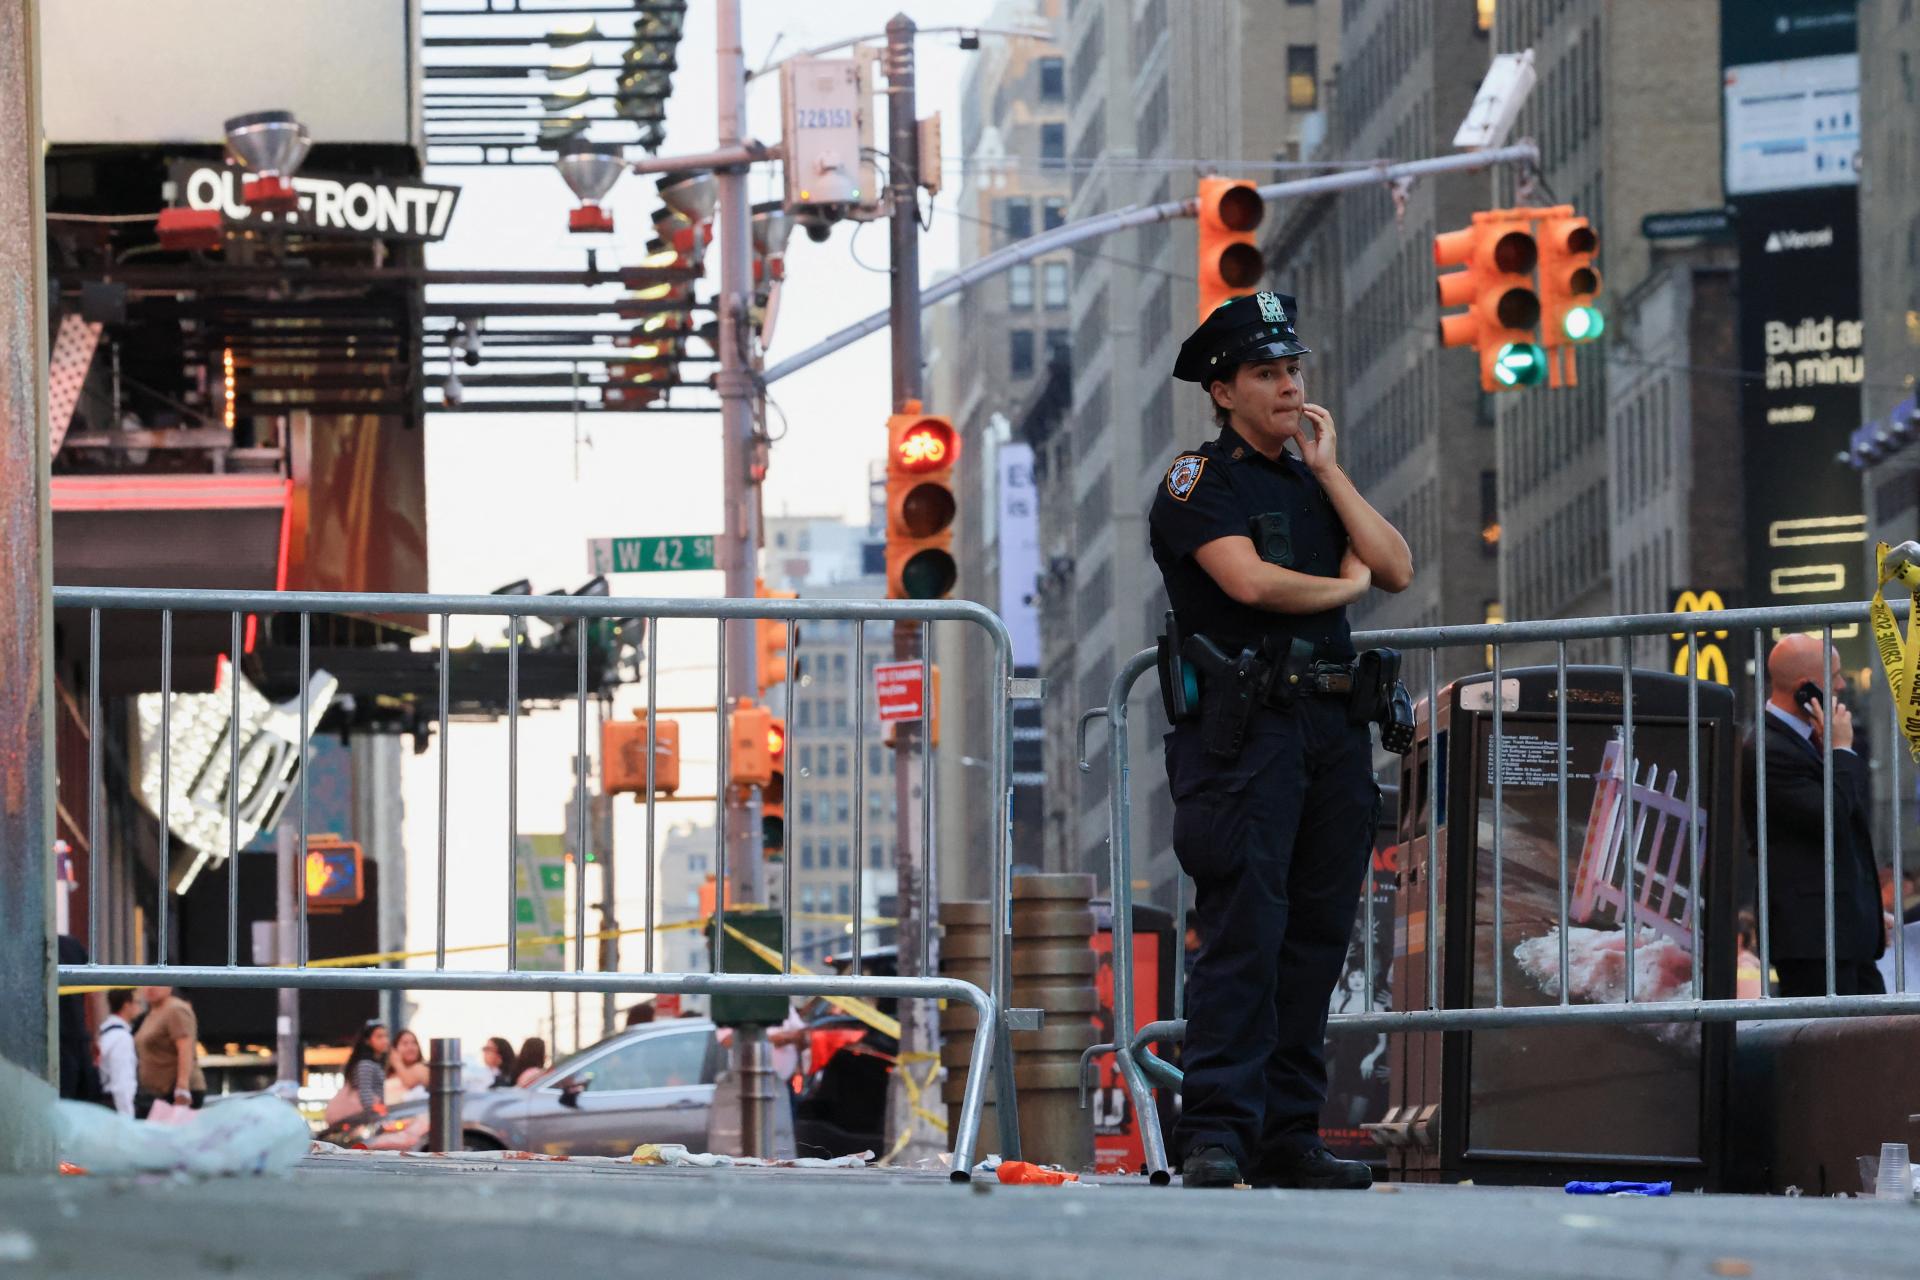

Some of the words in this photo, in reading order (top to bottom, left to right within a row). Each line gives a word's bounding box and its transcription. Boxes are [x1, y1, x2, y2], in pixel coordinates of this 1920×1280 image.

[1765, 316, 1834, 354] Build
[1766, 356, 1793, 390] in
[618, 541, 642, 570] W
[653, 540, 684, 569] 42
